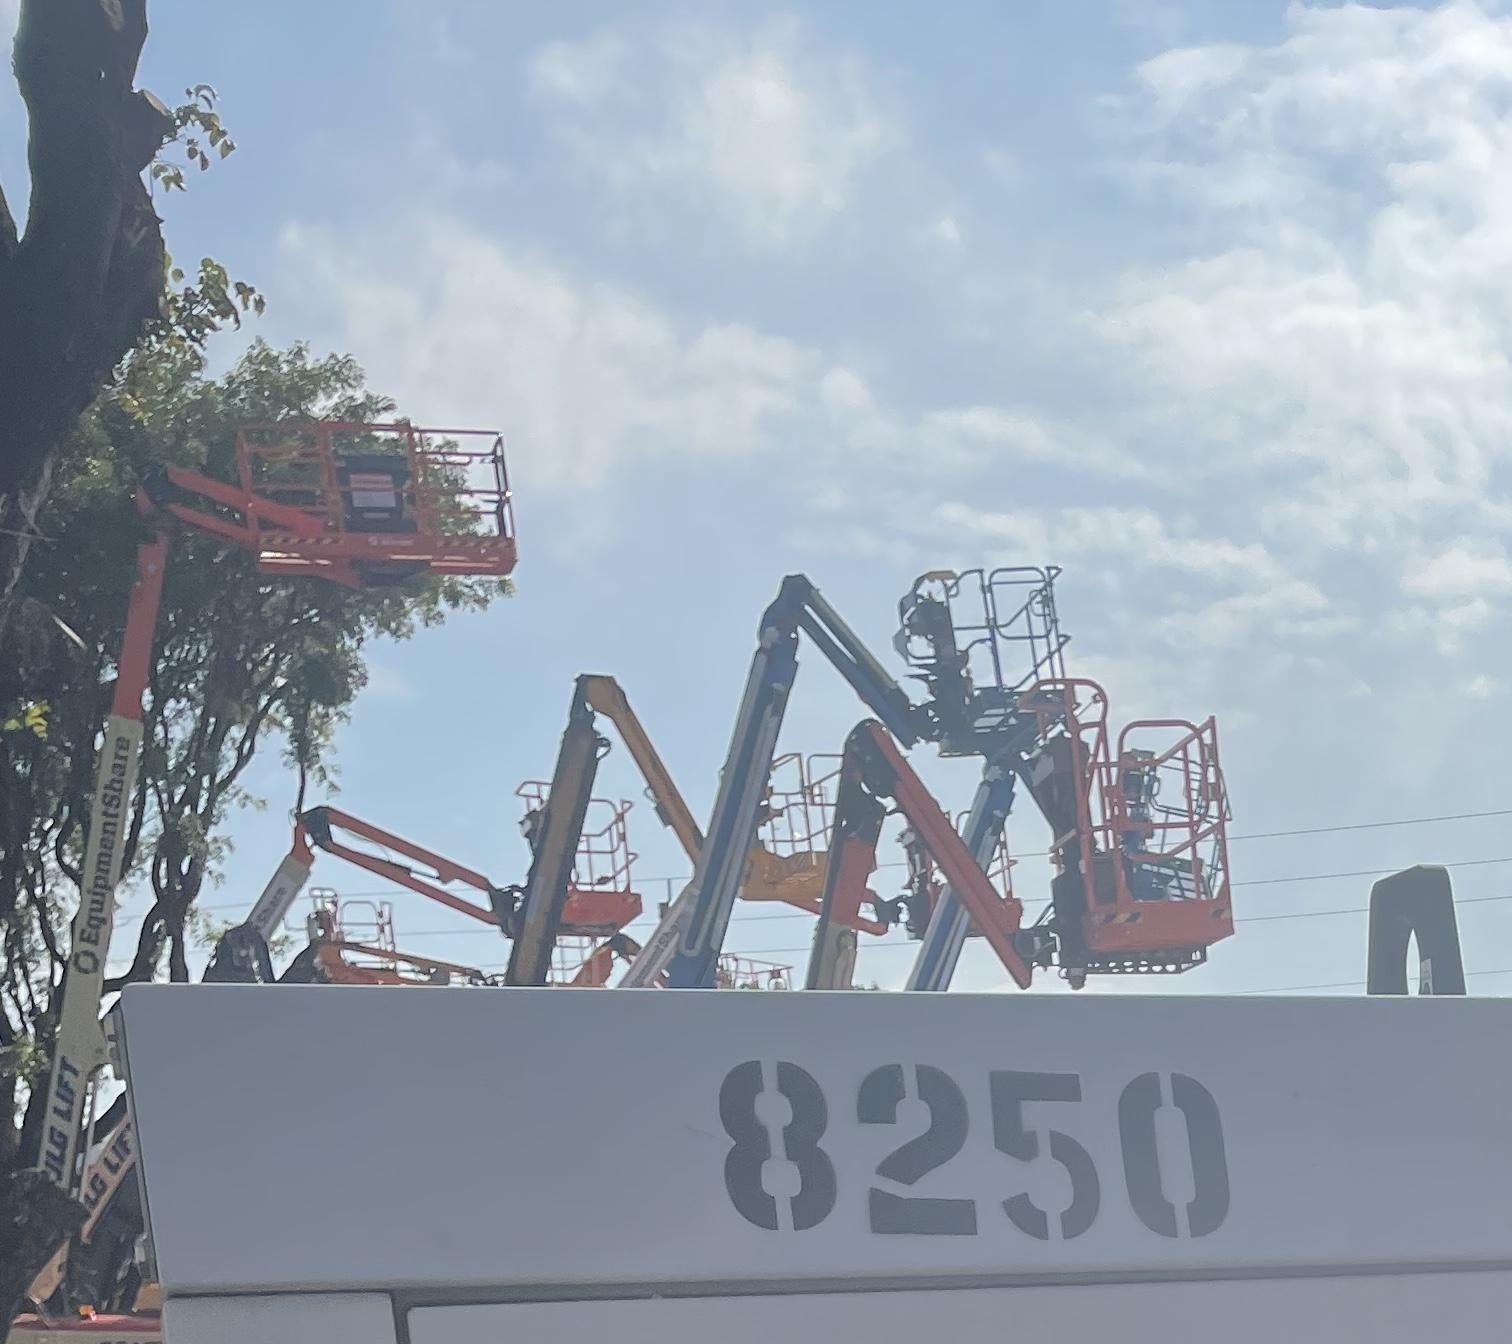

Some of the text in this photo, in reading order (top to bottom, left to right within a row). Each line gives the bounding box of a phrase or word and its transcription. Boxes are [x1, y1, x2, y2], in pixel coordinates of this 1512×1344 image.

[46, 1056, 80, 1182] JLG LIFT
[719, 1060, 1230, 1241] 8250
